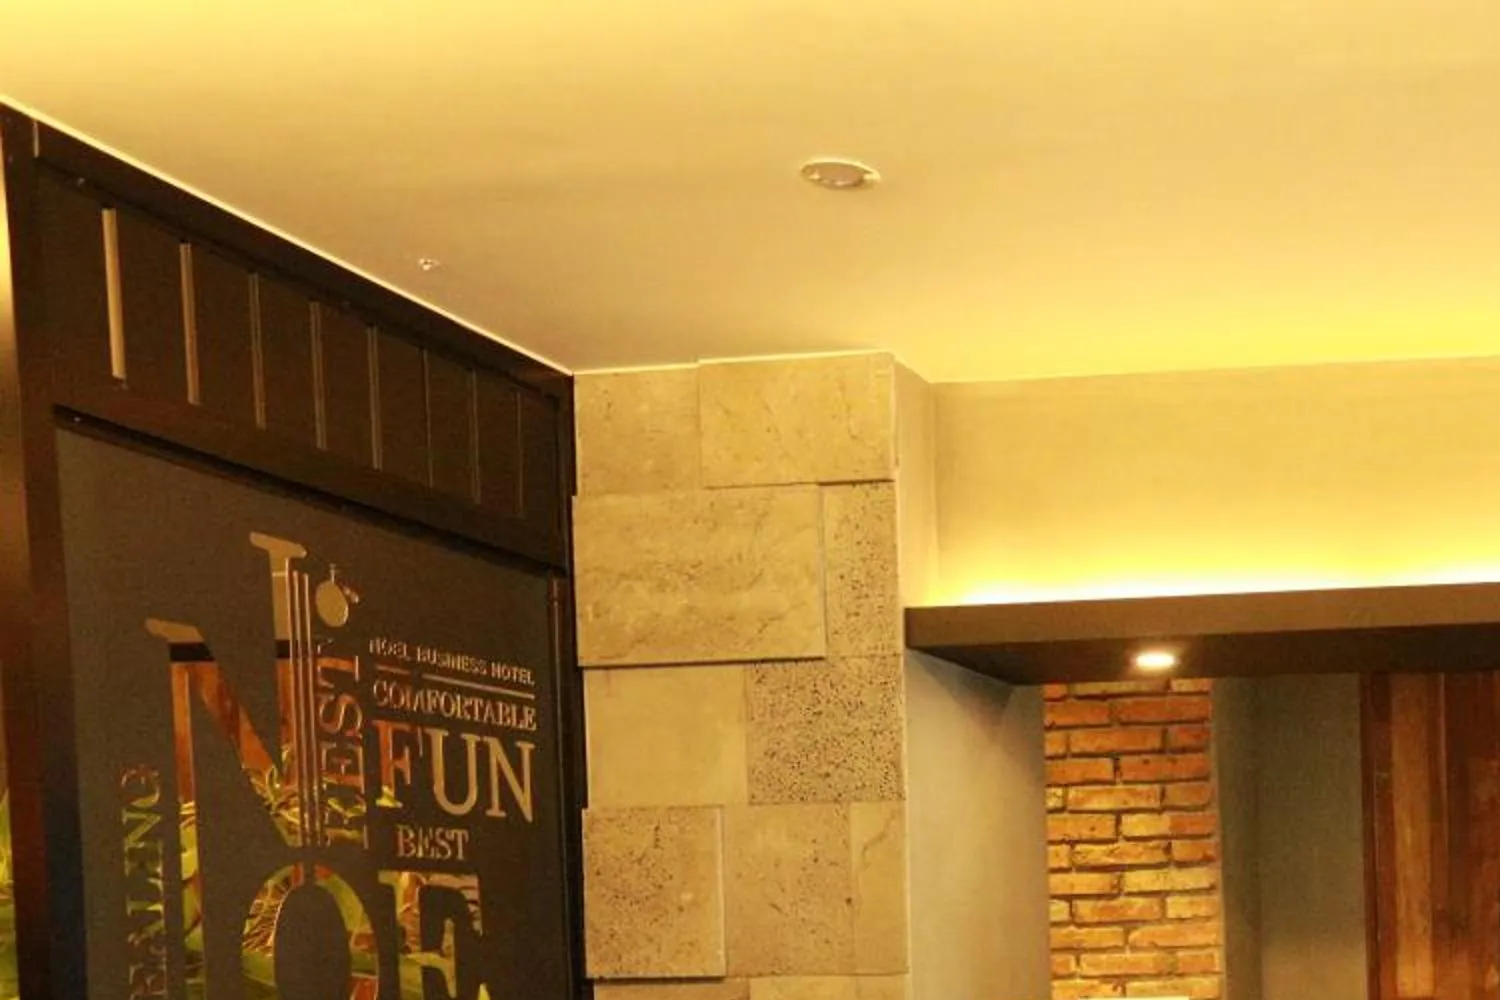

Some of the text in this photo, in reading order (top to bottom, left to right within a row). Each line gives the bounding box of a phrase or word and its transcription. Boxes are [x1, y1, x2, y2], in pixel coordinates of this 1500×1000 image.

[416, 646, 488, 677] BUSINESS
[491, 660, 535, 687] HOTEL
[372, 679, 538, 732] COMFORTABLE
[372, 719, 536, 823] FUN
[396, 823, 470, 862] BEST
